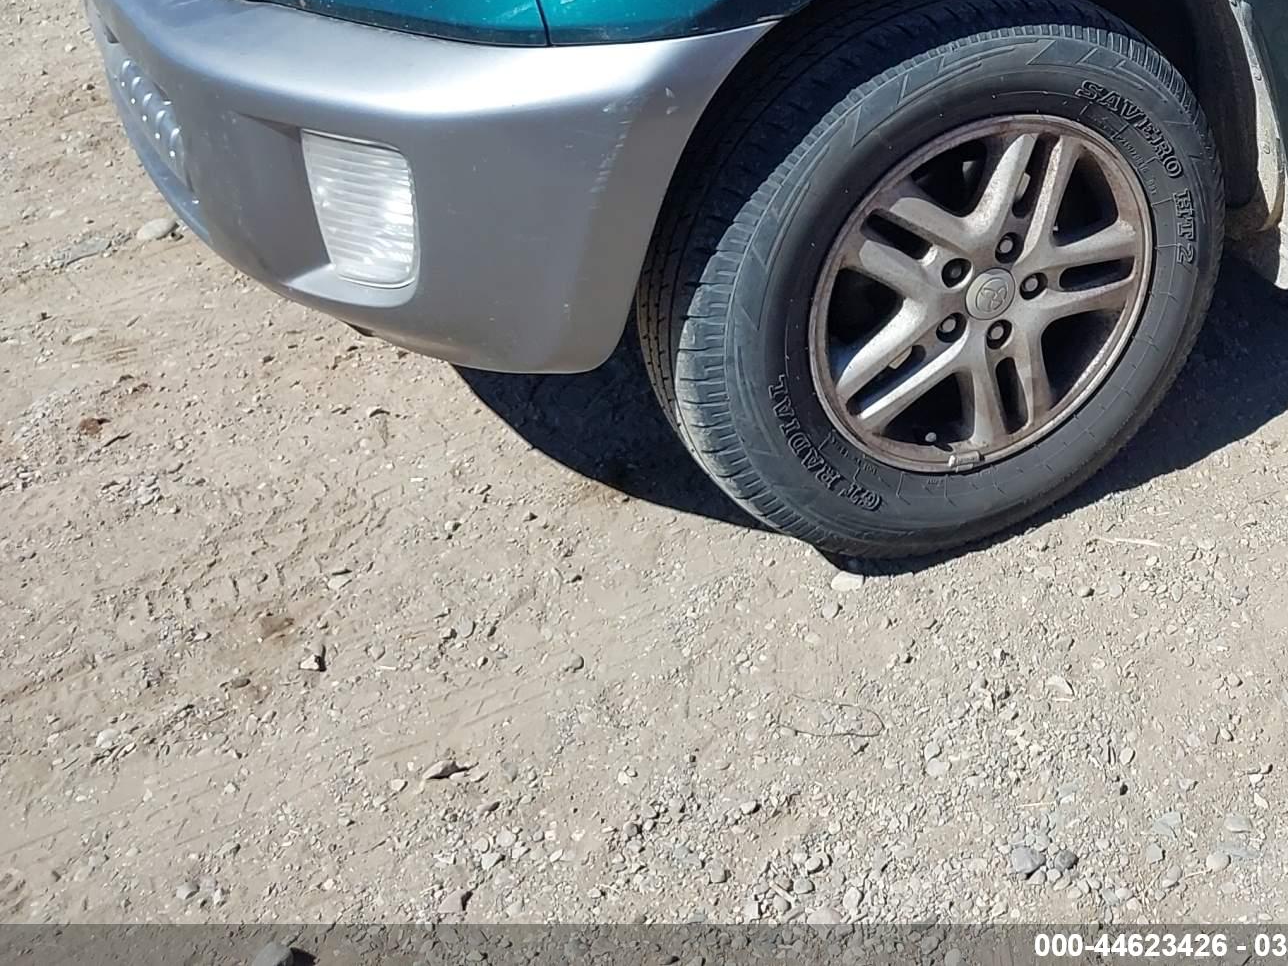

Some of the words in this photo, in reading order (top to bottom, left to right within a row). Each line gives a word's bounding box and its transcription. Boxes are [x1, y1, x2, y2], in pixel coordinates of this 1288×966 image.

[1075, 80, 1184, 179] SAVERO
[1173, 188, 1196, 240] HT
[1177, 242, 1195, 264] 2
[768, 374, 842, 492] RADIAL
[838, 482, 883, 512] GT
